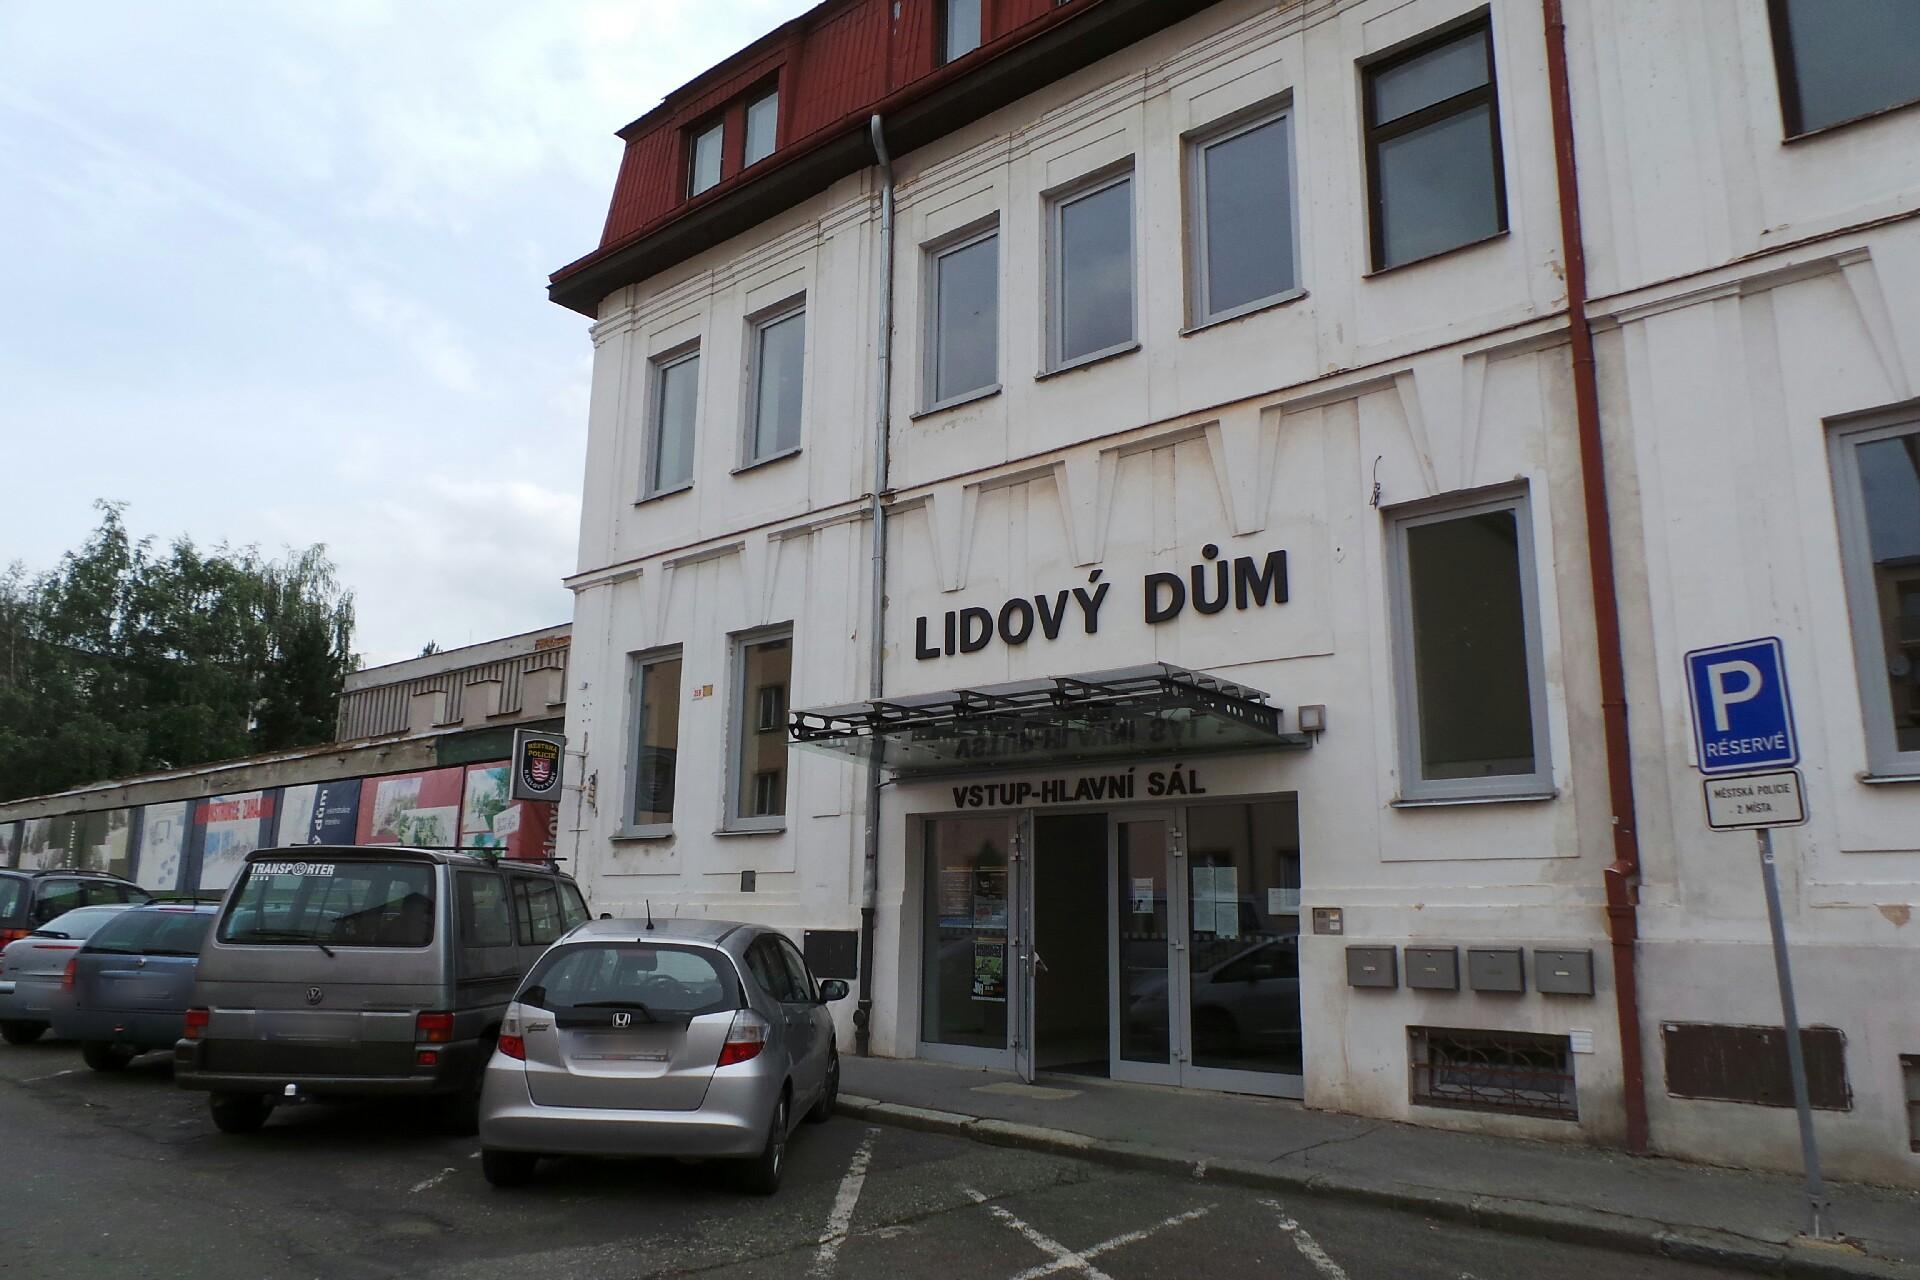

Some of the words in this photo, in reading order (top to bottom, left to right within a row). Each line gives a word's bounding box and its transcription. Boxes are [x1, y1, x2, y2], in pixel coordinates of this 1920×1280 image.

[916, 569, 1110, 660] LIDOVÝ
[1144, 543, 1289, 625] DŮM
[1707, 660, 1762, 732] P
[528, 751, 557, 760] POLICIE
[1706, 731, 1787, 758] RÉSERVÉ
[952, 767, 1136, 808] VSTUP-HLAVNÍ
[1147, 763, 1206, 797] SÁL
[1757, 783, 1791, 795] POLICIE
[1745, 802, 1773, 814] MÍSTA
